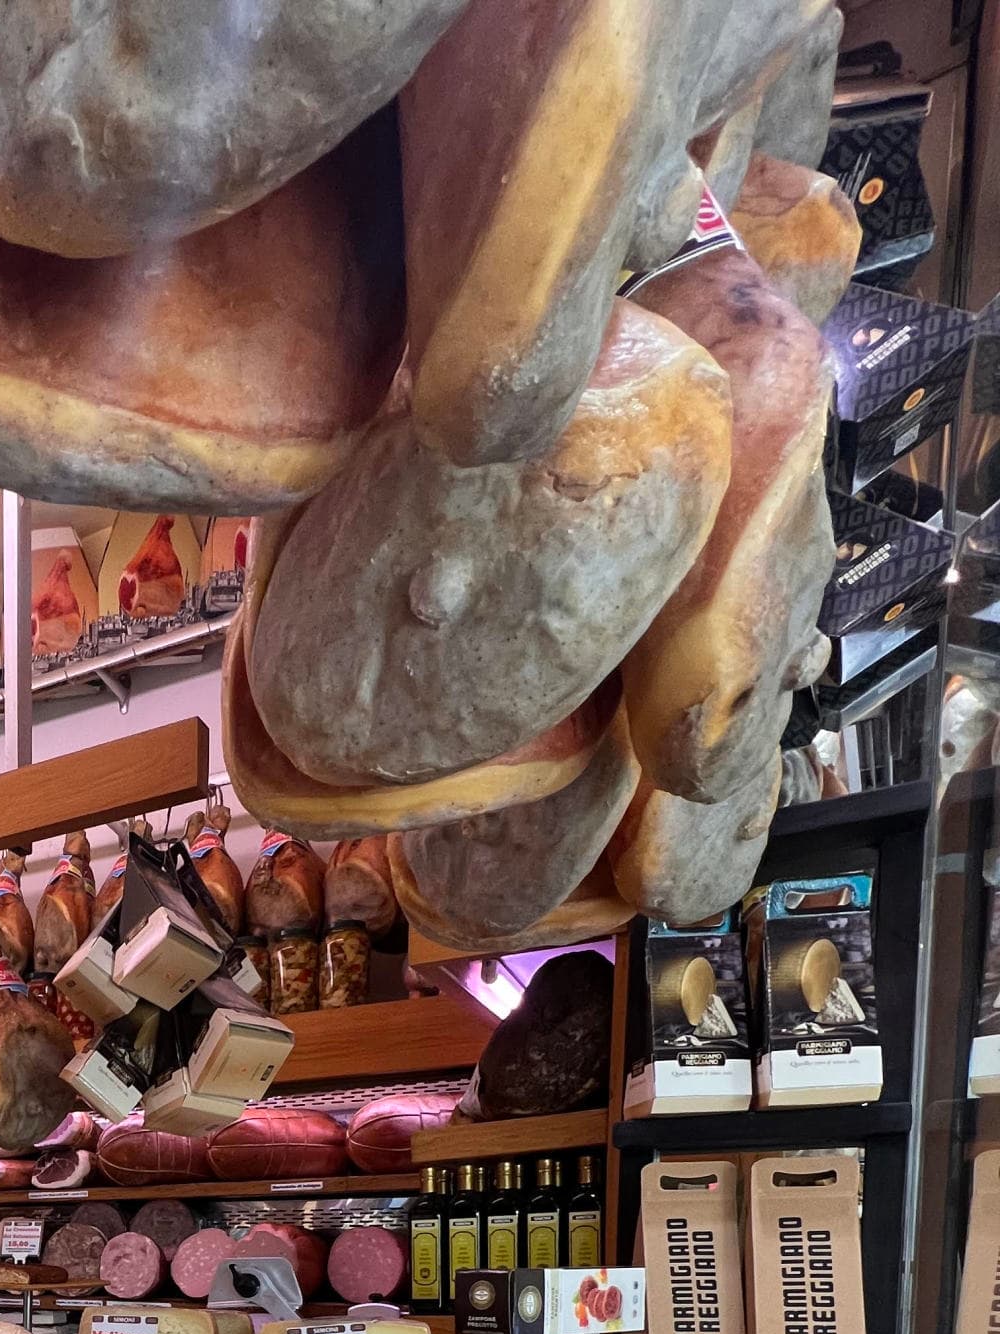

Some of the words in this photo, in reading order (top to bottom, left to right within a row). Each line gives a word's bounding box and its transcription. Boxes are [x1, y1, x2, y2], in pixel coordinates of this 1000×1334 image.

[856, 325, 911, 369] PARMIGIANO
[838, 543, 892, 583] PARMIGIANO
[692, 1230, 720, 1333] REGGIANO
